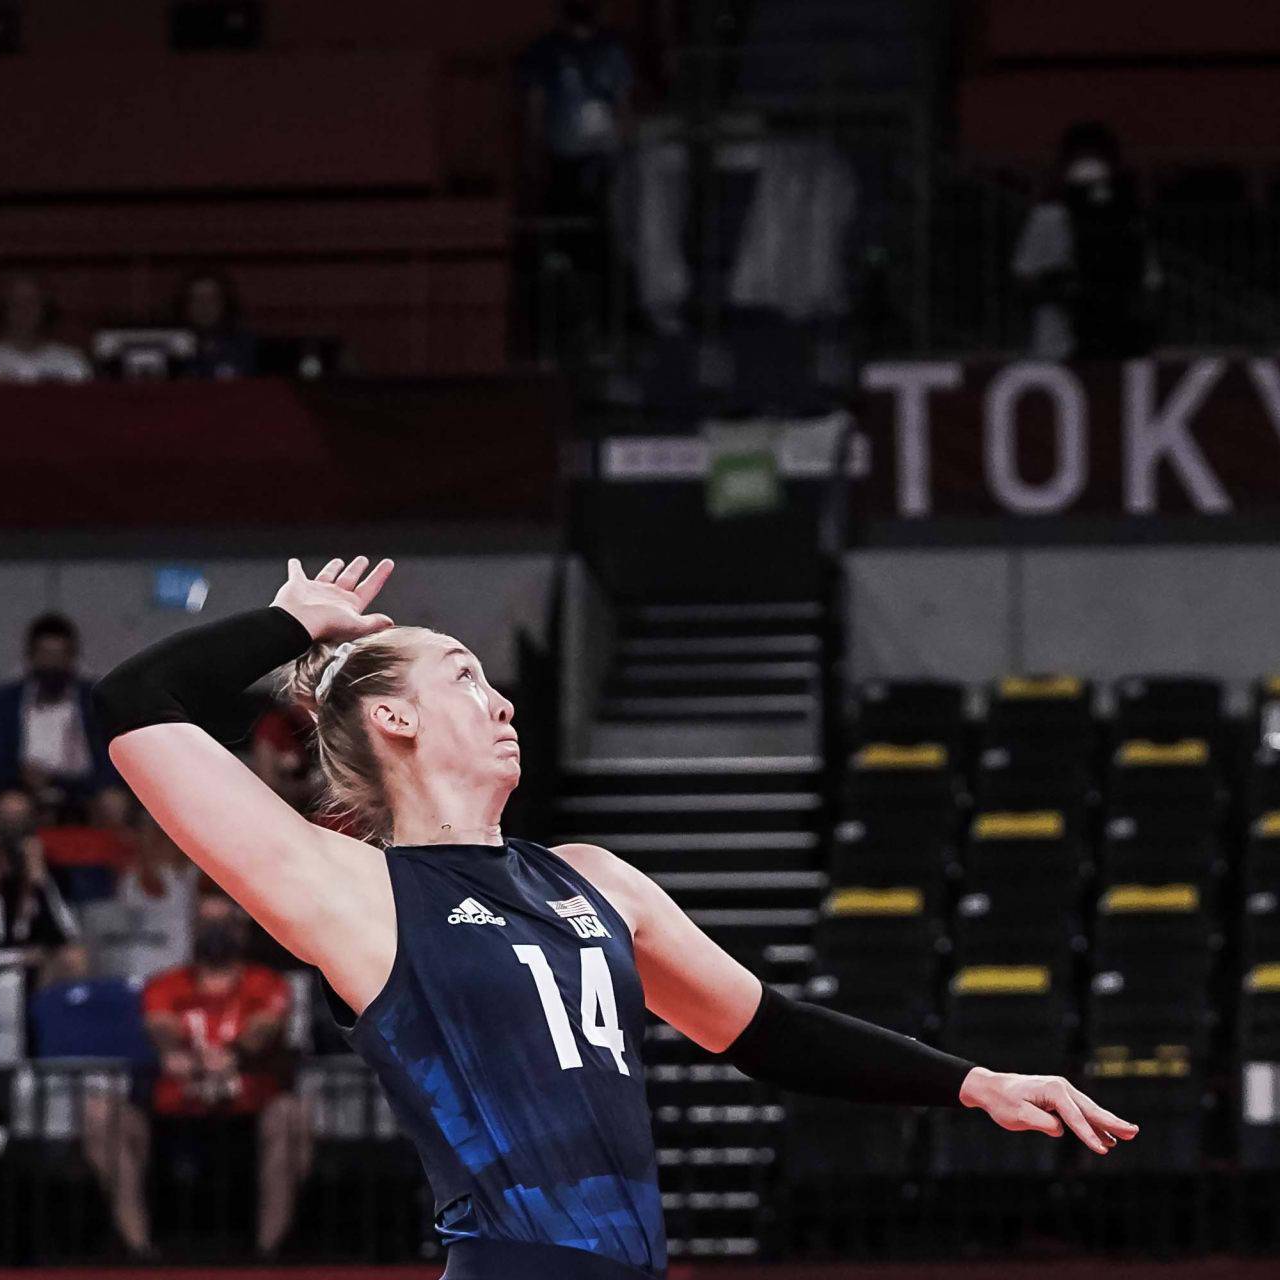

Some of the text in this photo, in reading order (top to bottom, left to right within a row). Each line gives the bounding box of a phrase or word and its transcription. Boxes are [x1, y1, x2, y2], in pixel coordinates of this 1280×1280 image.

[447, 909, 507, 926] adidas
[567, 916, 613, 939] USA
[511, 944, 631, 1076] 14
